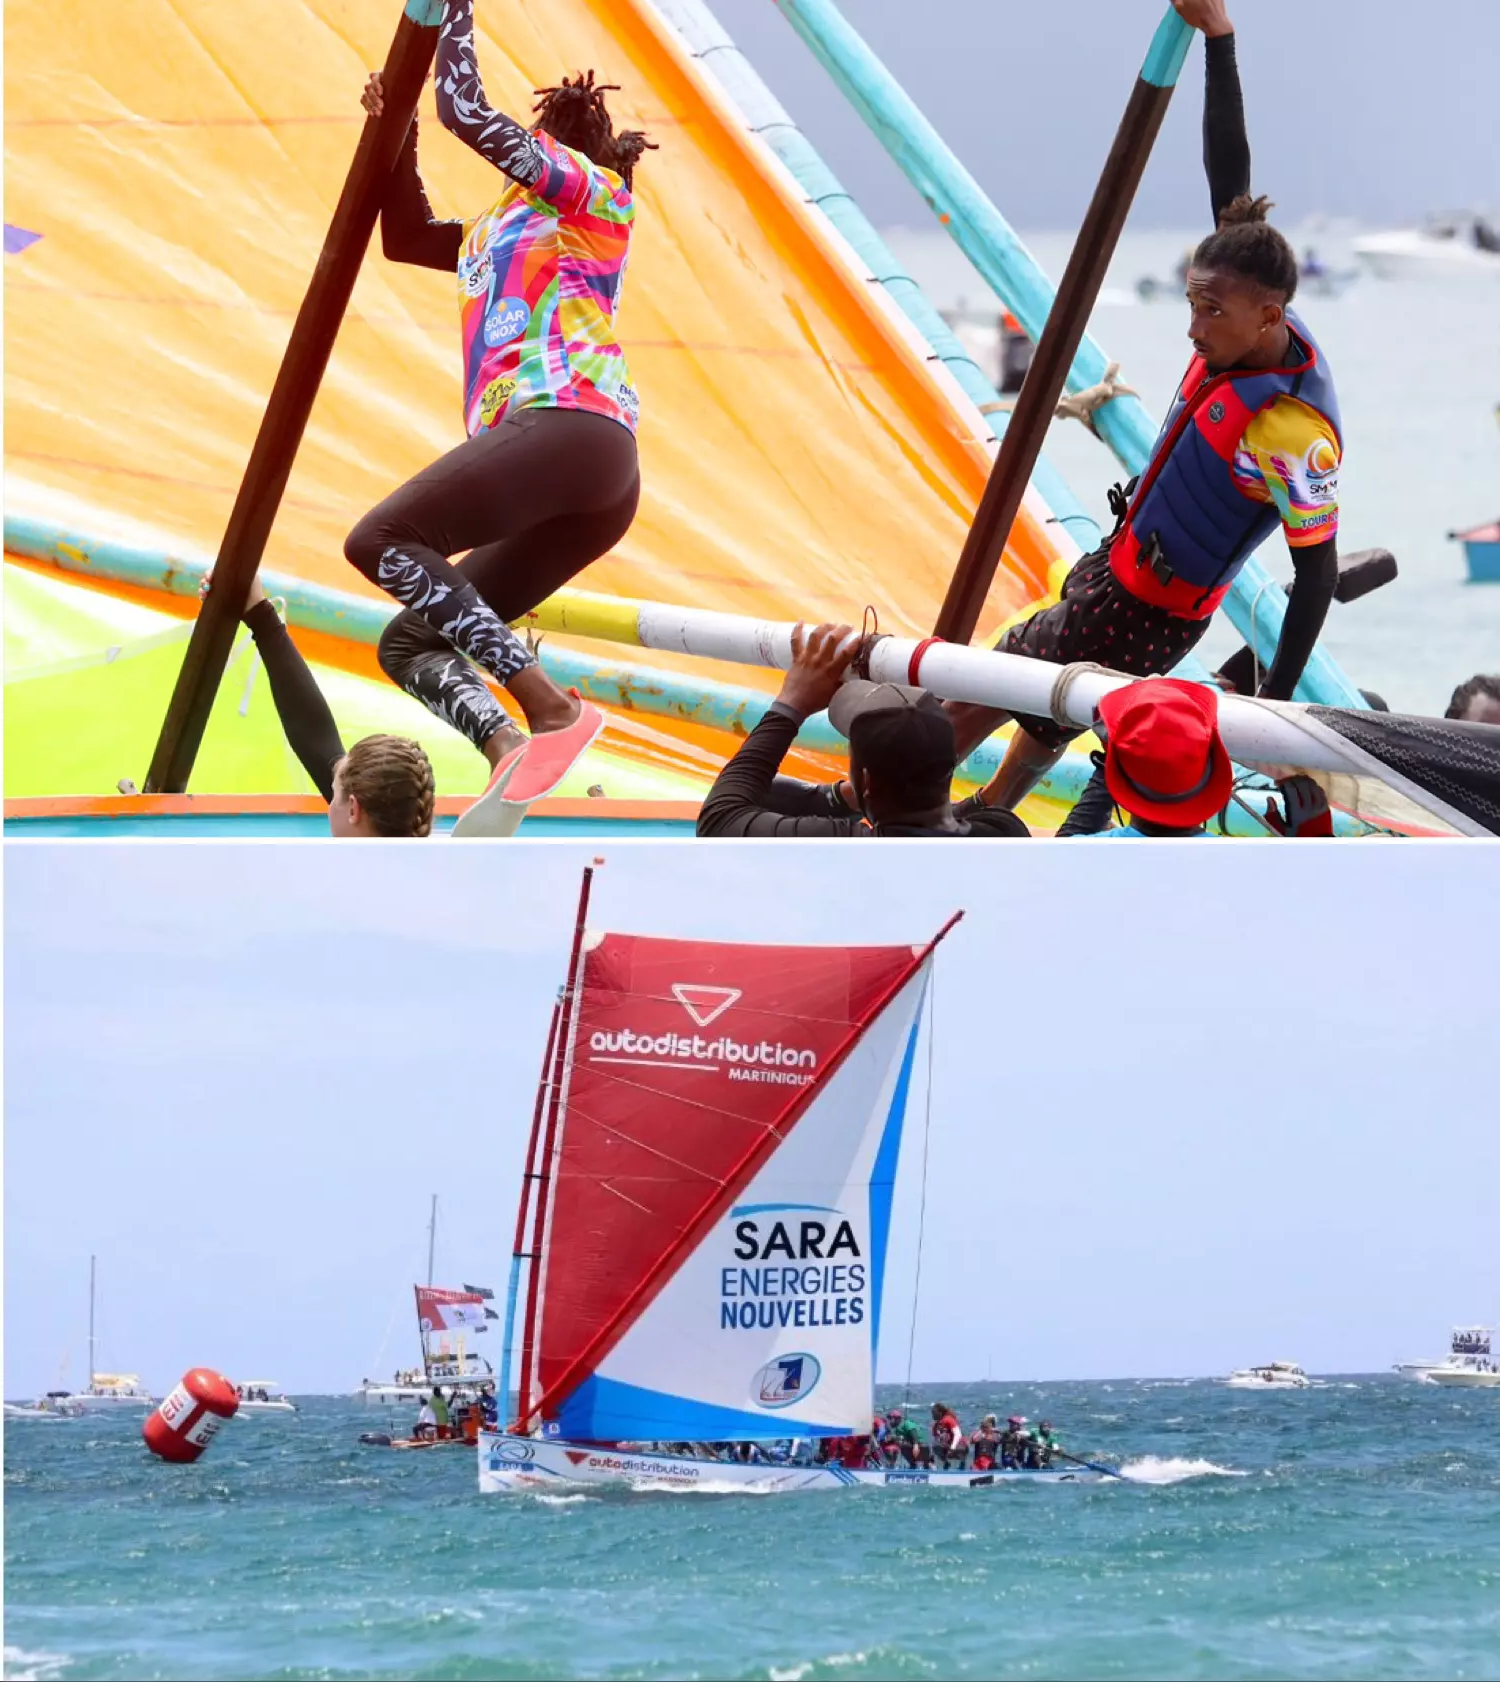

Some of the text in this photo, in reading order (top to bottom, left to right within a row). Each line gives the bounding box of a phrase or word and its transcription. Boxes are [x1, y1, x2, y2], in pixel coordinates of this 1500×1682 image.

[484, 309, 526, 332] SOLAR
[489, 323, 519, 342] INOX
[1300, 514, 1328, 528] TOUR
[589, 1028, 817, 1068] autodistribution
[734, 1220, 861, 1260] SARA
[721, 1264, 866, 1297] ENERGIES
[720, 1297, 864, 1330] NOUVELLES
[589, 1457, 700, 1477] autodistribution
